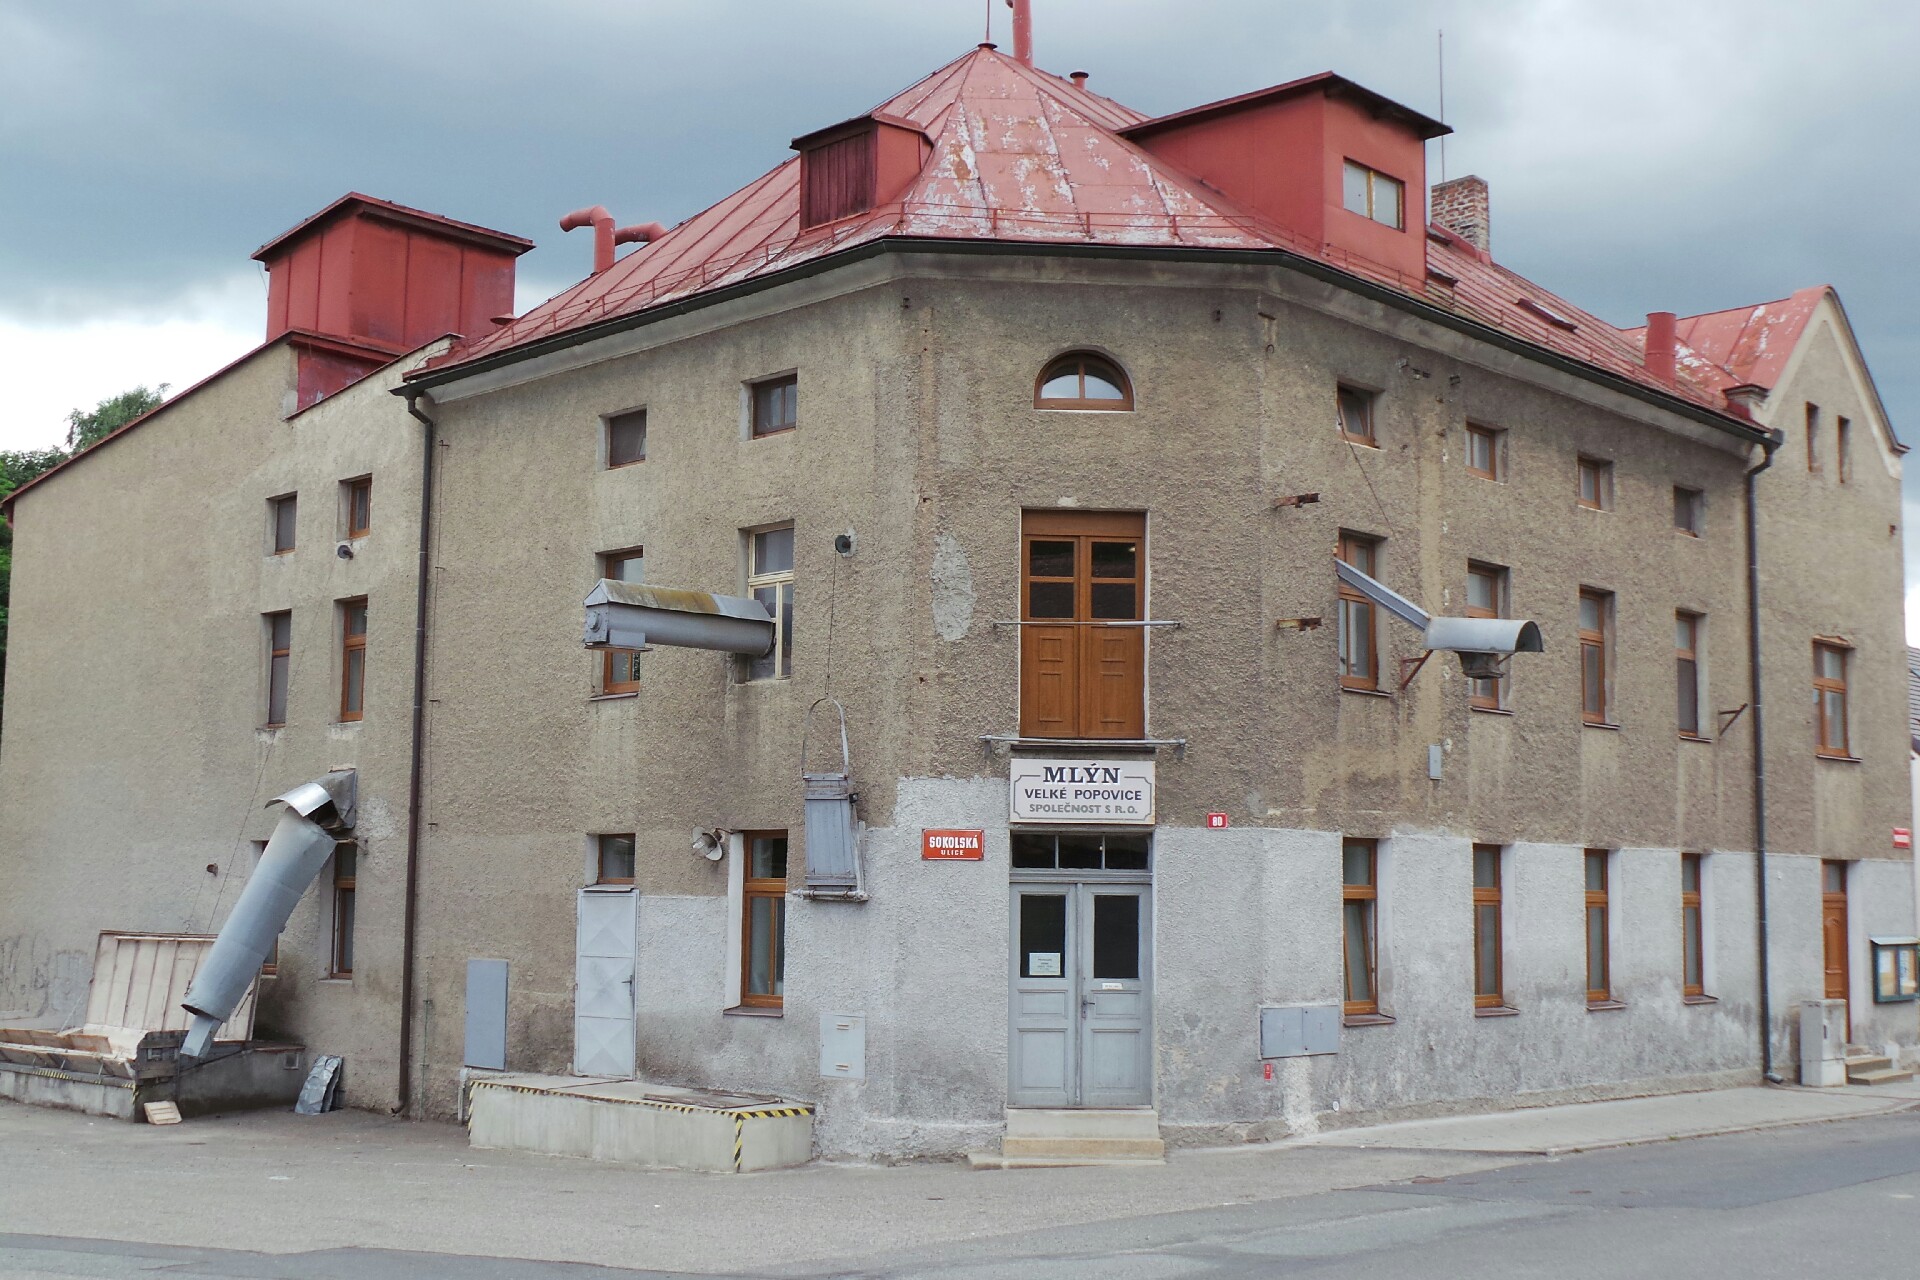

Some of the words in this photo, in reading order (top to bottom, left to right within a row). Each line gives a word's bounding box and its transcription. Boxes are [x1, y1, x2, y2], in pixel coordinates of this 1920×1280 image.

[1043, 763, 1121, 784] MLÝN
[1025, 787, 1067, 800] VELKÉ
[1074, 789, 1142, 801] POPOVICE
[1029, 802, 1101, 814] SPOLEČNOST
[1104, 804, 1111, 814] S
[1212, 816, 1223, 827] 80
[929, 834, 979, 849] SOKOLSKÁ
